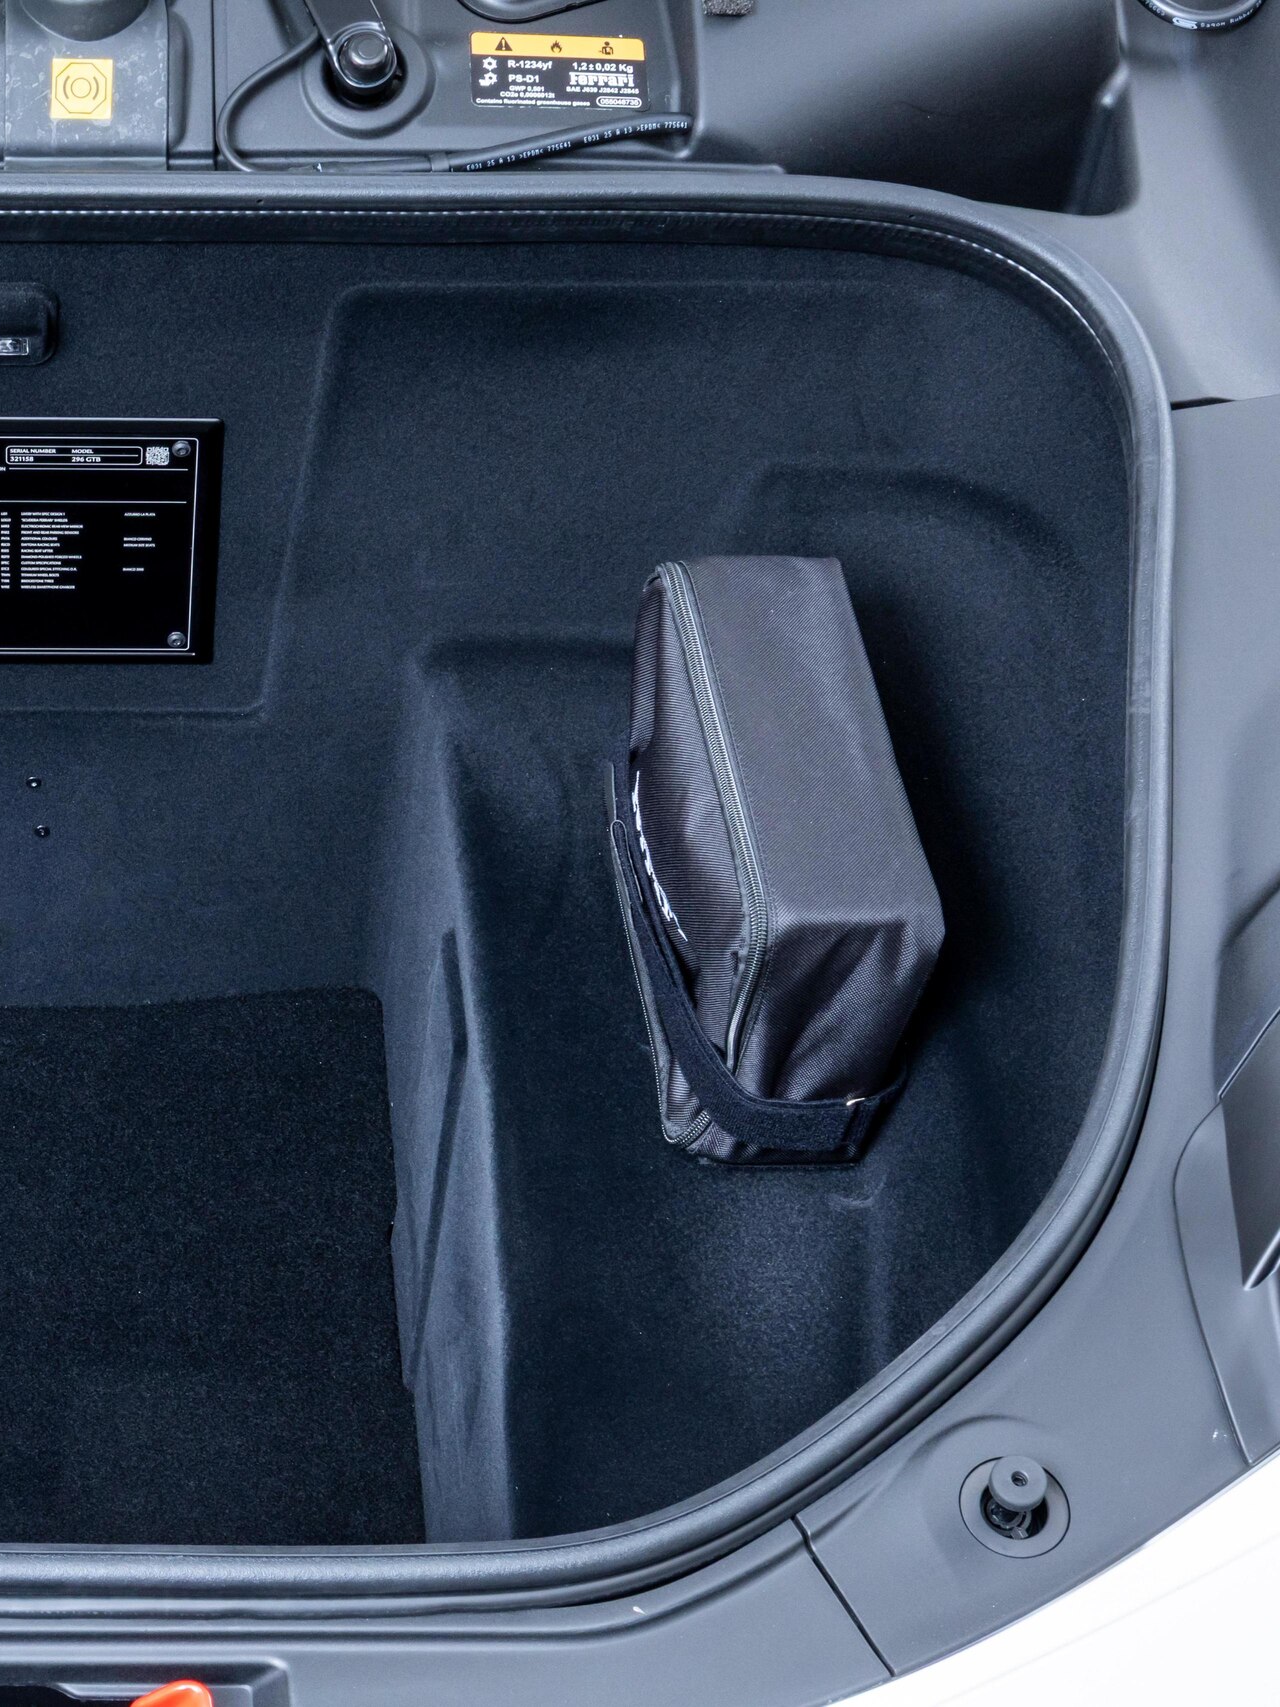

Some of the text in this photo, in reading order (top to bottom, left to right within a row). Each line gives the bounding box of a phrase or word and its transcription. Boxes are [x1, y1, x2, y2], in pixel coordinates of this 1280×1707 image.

[507, 60, 553, 71] R-1234yf
[618, 64, 634, 73] Kg
[508, 75, 540, 83] PS-D1
[569, 72, 634, 87] Ferrari
[604, 130, 612, 138] 25
